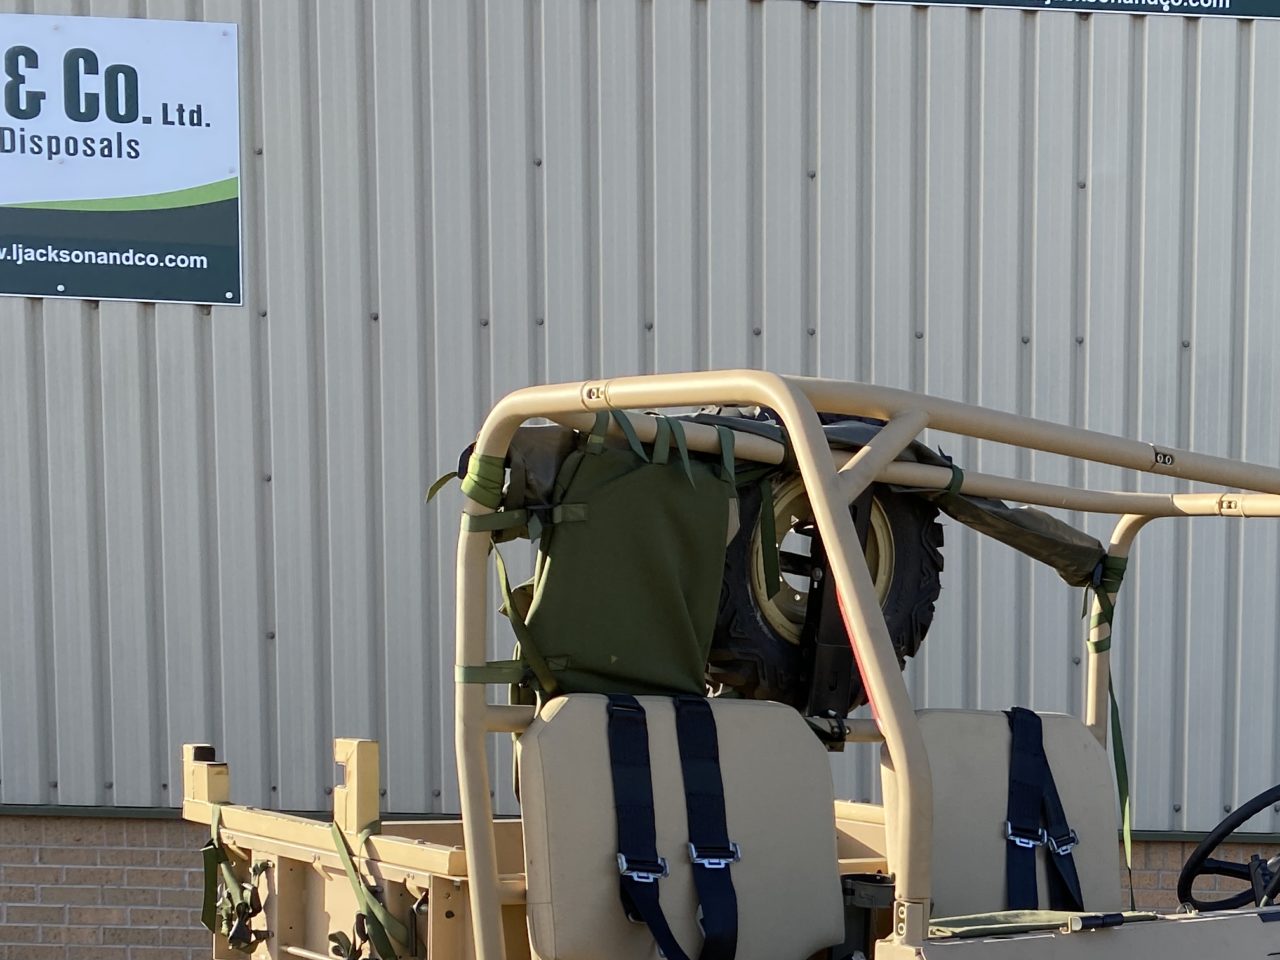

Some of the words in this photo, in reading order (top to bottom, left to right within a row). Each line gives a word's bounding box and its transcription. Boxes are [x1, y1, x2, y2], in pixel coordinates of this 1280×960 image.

[4, 45, 46, 120] &
[63, 47, 152, 124] Co.
[162, 102, 211, 127] Ltd.
[0, 126, 140, 160] Disposals
